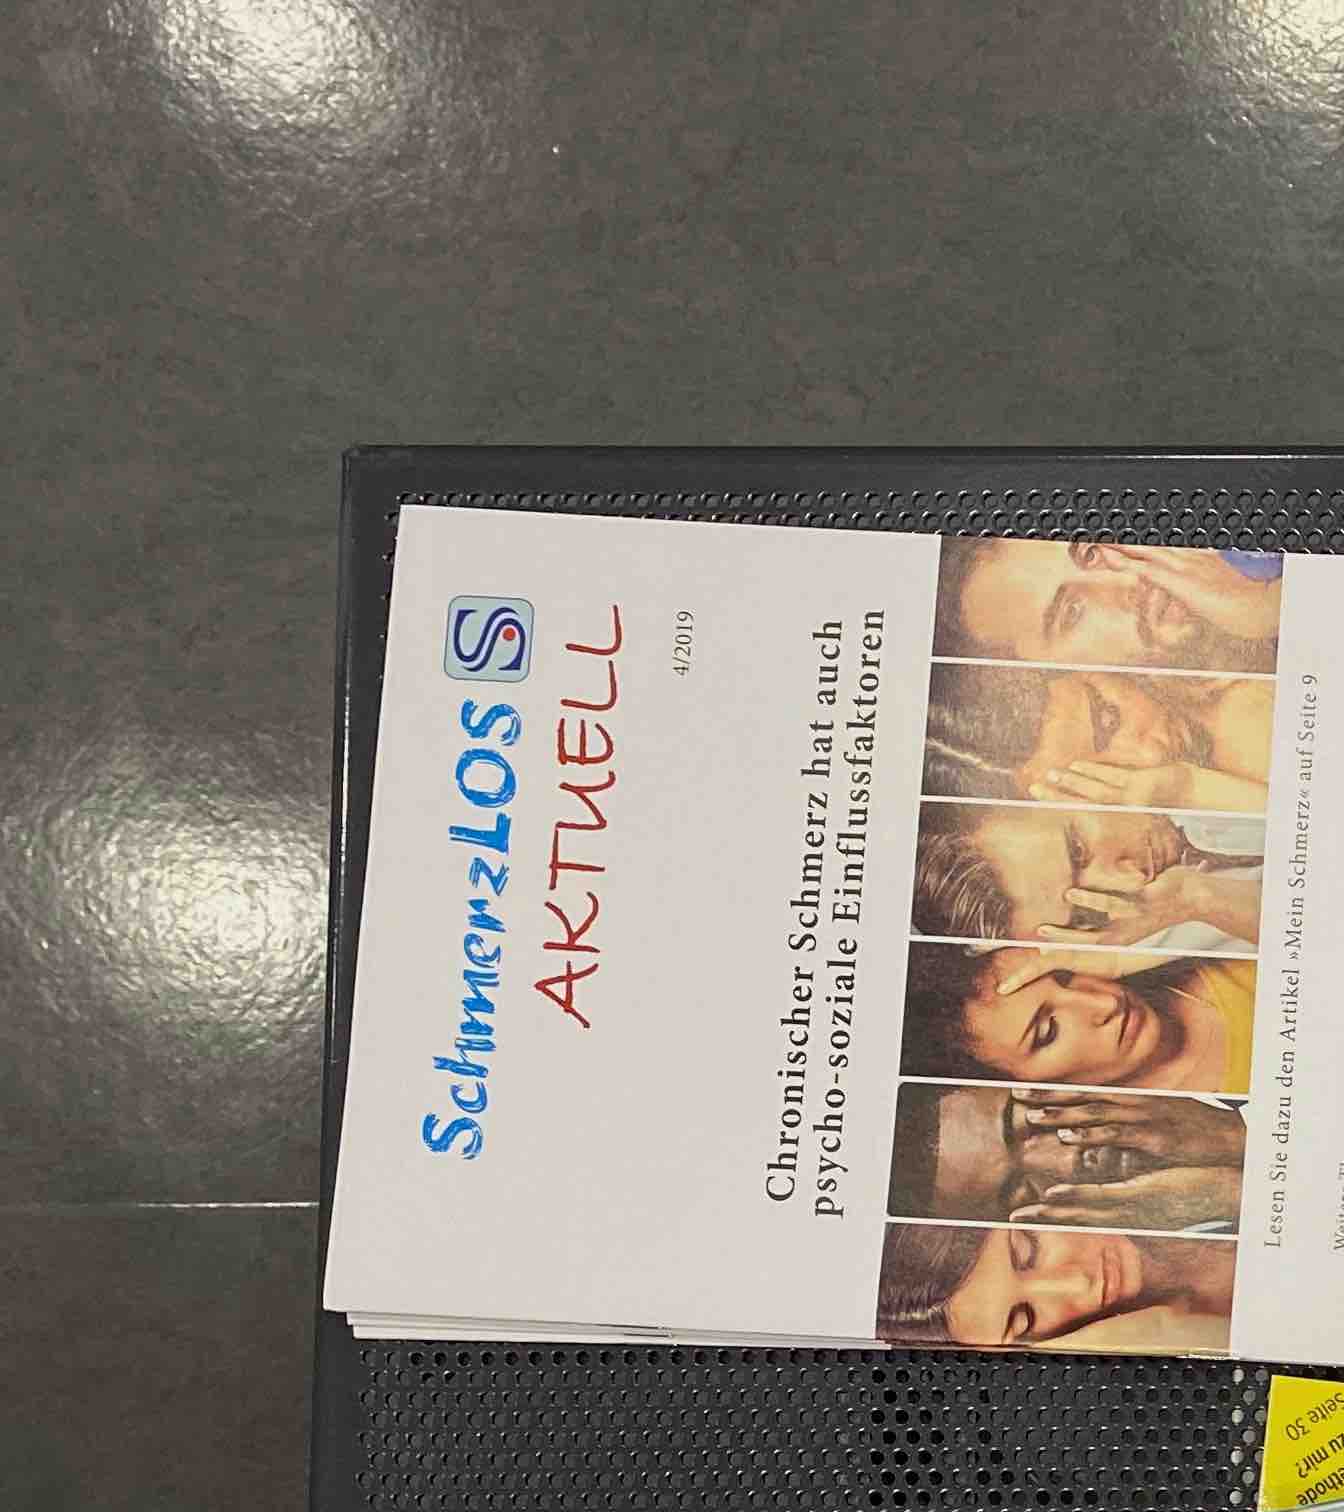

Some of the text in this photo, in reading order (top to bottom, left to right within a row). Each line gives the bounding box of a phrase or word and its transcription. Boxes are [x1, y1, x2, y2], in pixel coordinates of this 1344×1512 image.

[672, 610, 694, 676] 4/2019
[1303, 675, 1317, 685] 9
[1297, 693, 1317, 741] Seite
[1296, 748, 1313, 781] auf
[535, 604, 622, 1029] AKTUELL
[767, 619, 843, 1201] Chronischer Schmerz hat auch
[815, 609, 885, 1218] psycho-soziale Einflussfaktoren
[1280, 968, 1300, 1042] Artikel
[1276, 1052, 1295, 1087] den
[1272, 1097, 1292, 1144] dazu
[1270, 1152, 1288, 1182] Sie
[1265, 1192, 1285, 1248] Lesen
